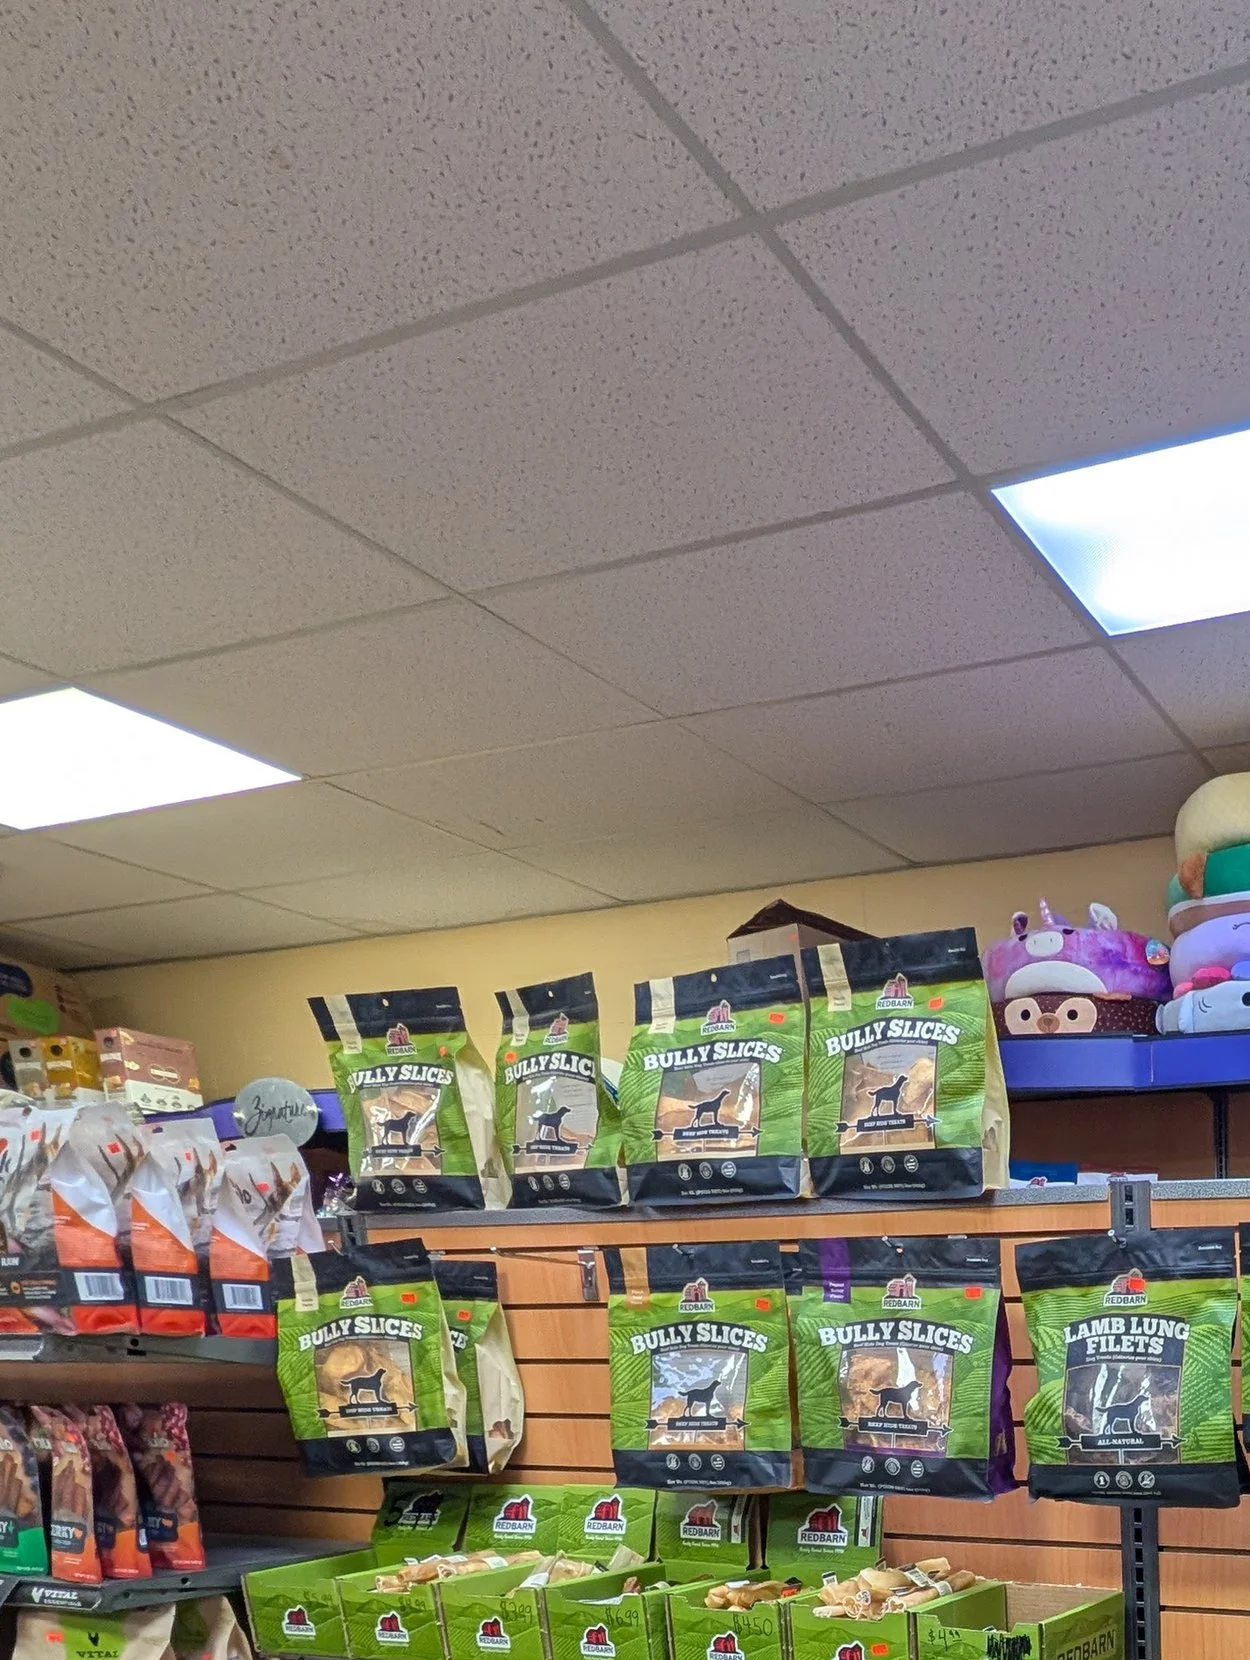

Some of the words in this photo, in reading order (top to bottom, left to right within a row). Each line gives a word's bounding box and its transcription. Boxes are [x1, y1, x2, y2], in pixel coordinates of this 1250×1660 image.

[825, 1022, 885, 1057] BULLY
[886, 1017, 961, 1044] SLICES
[643, 1045, 709, 1072] BULLY
[712, 1041, 783, 1063] SLICES
[347, 1066, 398, 1093] BULLY
[400, 1064, 455, 1085] SLICES
[504, 1056, 548, 1085] BULLY
[883, 1299, 921, 1308] REDBARN
[1105, 1296, 1146, 1304] REDBARN
[299, 1322, 350, 1351] BULLY
[354, 1316, 423, 1341] SLICES
[629, 1326, 694, 1354] BULLY
[696, 1323, 769, 1353] SLICES
[818, 1322, 891, 1347] BULLY
[897, 1321, 974, 1353] SLICES
[1064, 1317, 1126, 1343] LAMB
[1130, 1317, 1190, 1340] LUNG
[1086, 1336, 1164, 1354] FILETS
[495, 1521, 536, 1533] REDBARN
[586, 1521, 624, 1532] REDBARN
[801, 1531, 847, 1545] REDBARN
[44, 1590, 78, 1599] VITAL
[76, 1651, 117, 1659] VITAL
